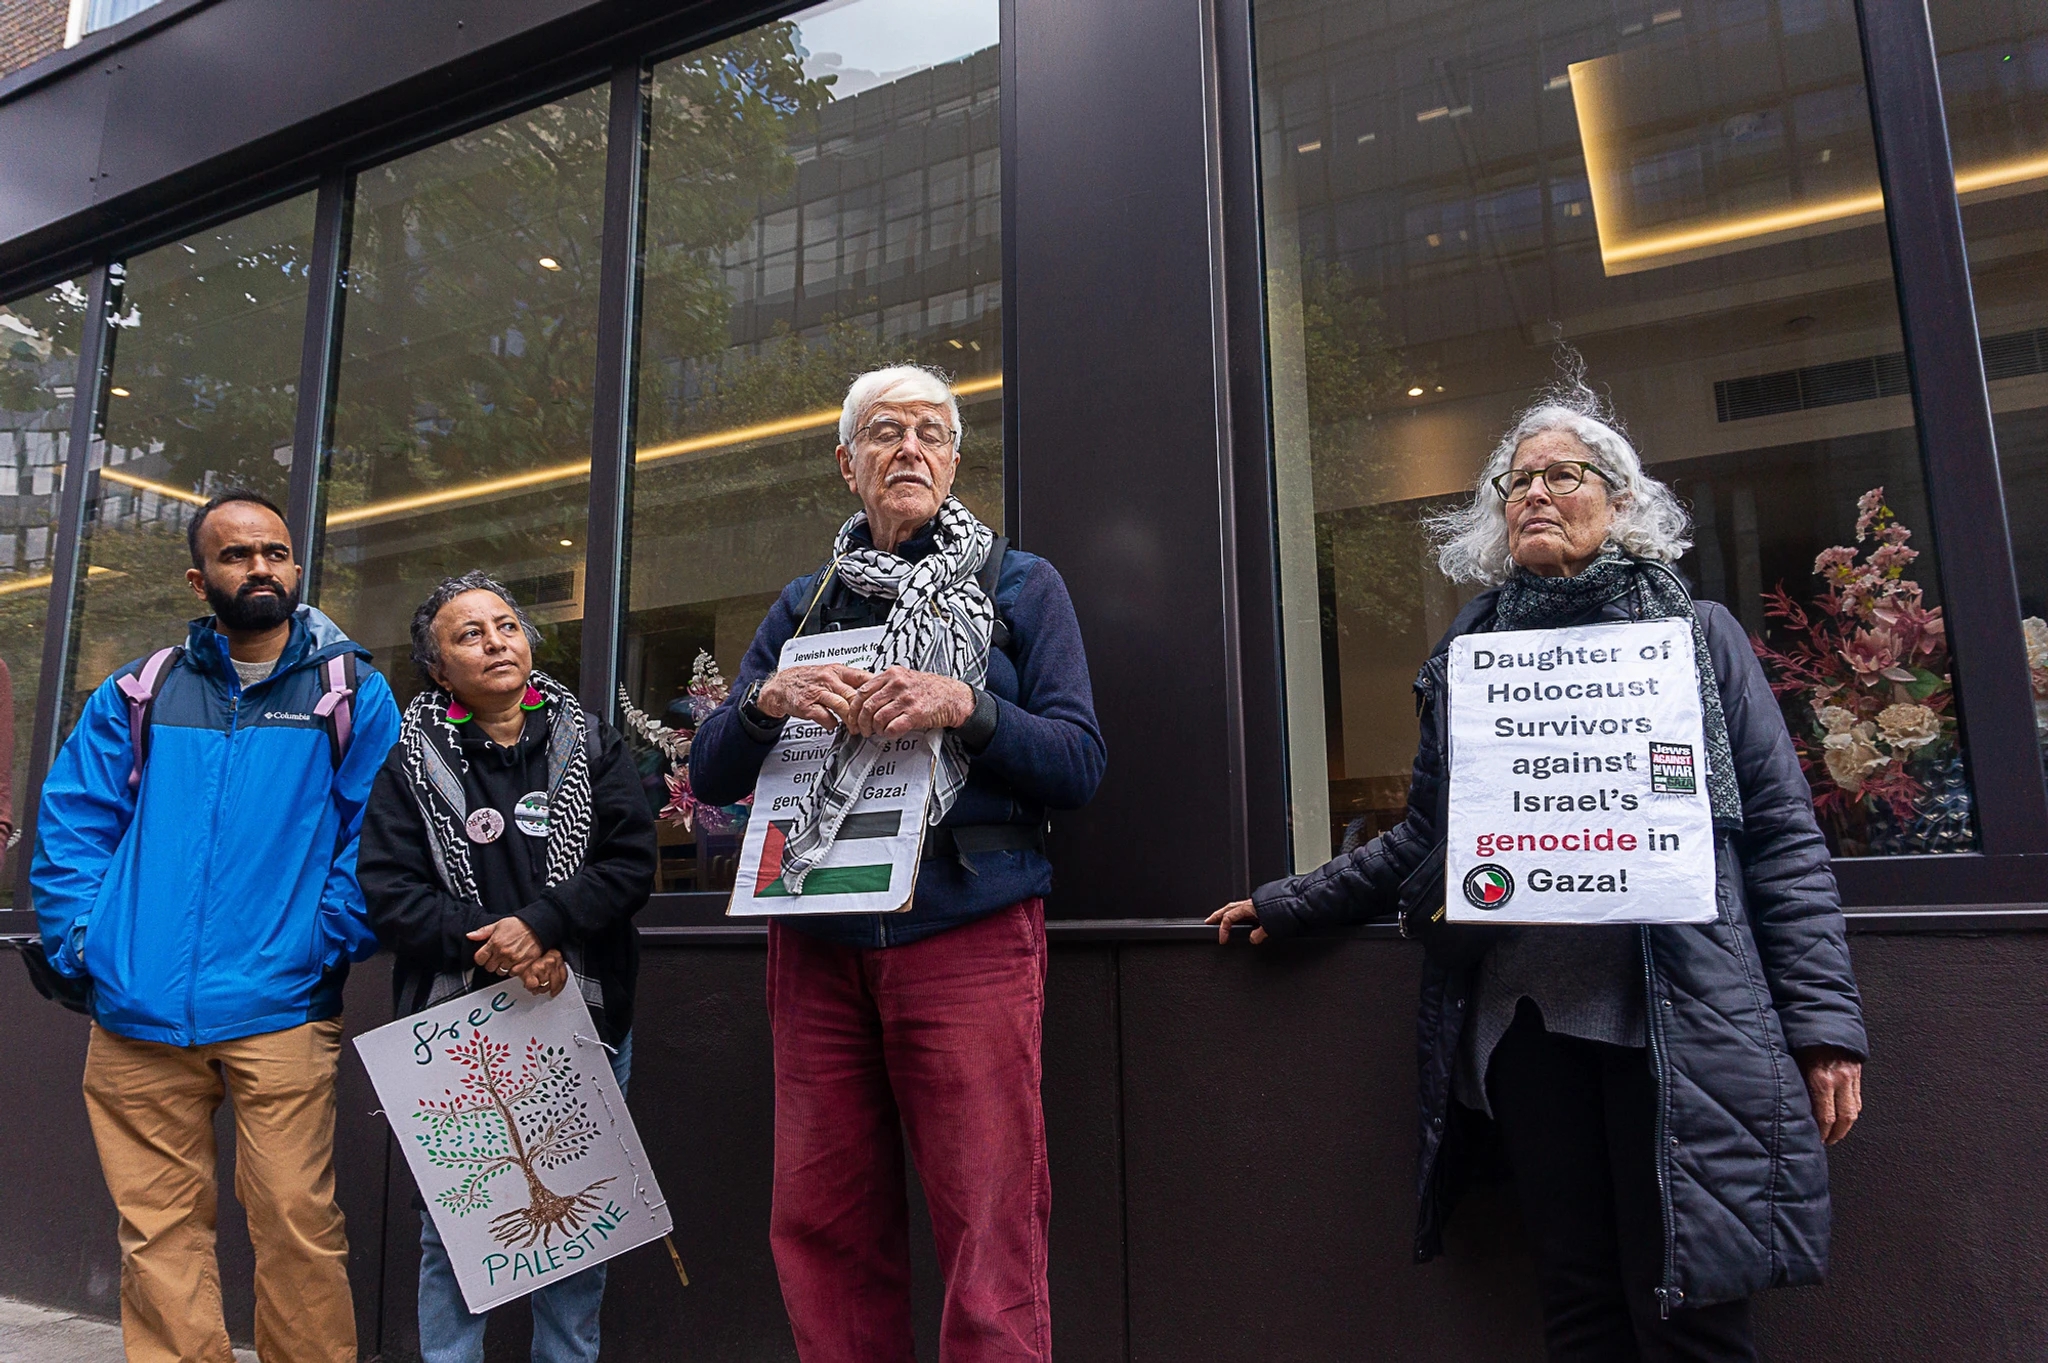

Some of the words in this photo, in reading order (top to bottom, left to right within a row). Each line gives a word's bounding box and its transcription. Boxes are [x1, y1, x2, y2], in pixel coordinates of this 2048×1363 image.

[794, 650, 825, 662] Jewish
[827, 643, 868, 657] Network
[869, 641, 879, 651] fo
[1473, 646, 1622, 671] Daughter
[1639, 640, 1672, 660] of
[1487, 677, 1659, 703] Holocaust
[273, 711, 310, 721] Columbia
[1494, 714, 1653, 738] Survivors
[781, 728, 792, 740] A
[794, 724, 823, 739] Son
[781, 745, 829, 762] Surviv
[895, 738, 919, 751] for
[1652, 744, 1691, 755] Jews
[1652, 754, 1692, 765] AGAINST
[867, 760, 896, 777] aeli
[1512, 751, 1638, 779] against
[1662, 764, 1693, 777] WAR
[862, 782, 909, 799] Gaza!
[1513, 788, 1639, 812] Israel’s
[1476, 828, 1638, 857] genocide
[1648, 828, 1680, 851] in
[1527, 868, 1629, 893] Gaza!
